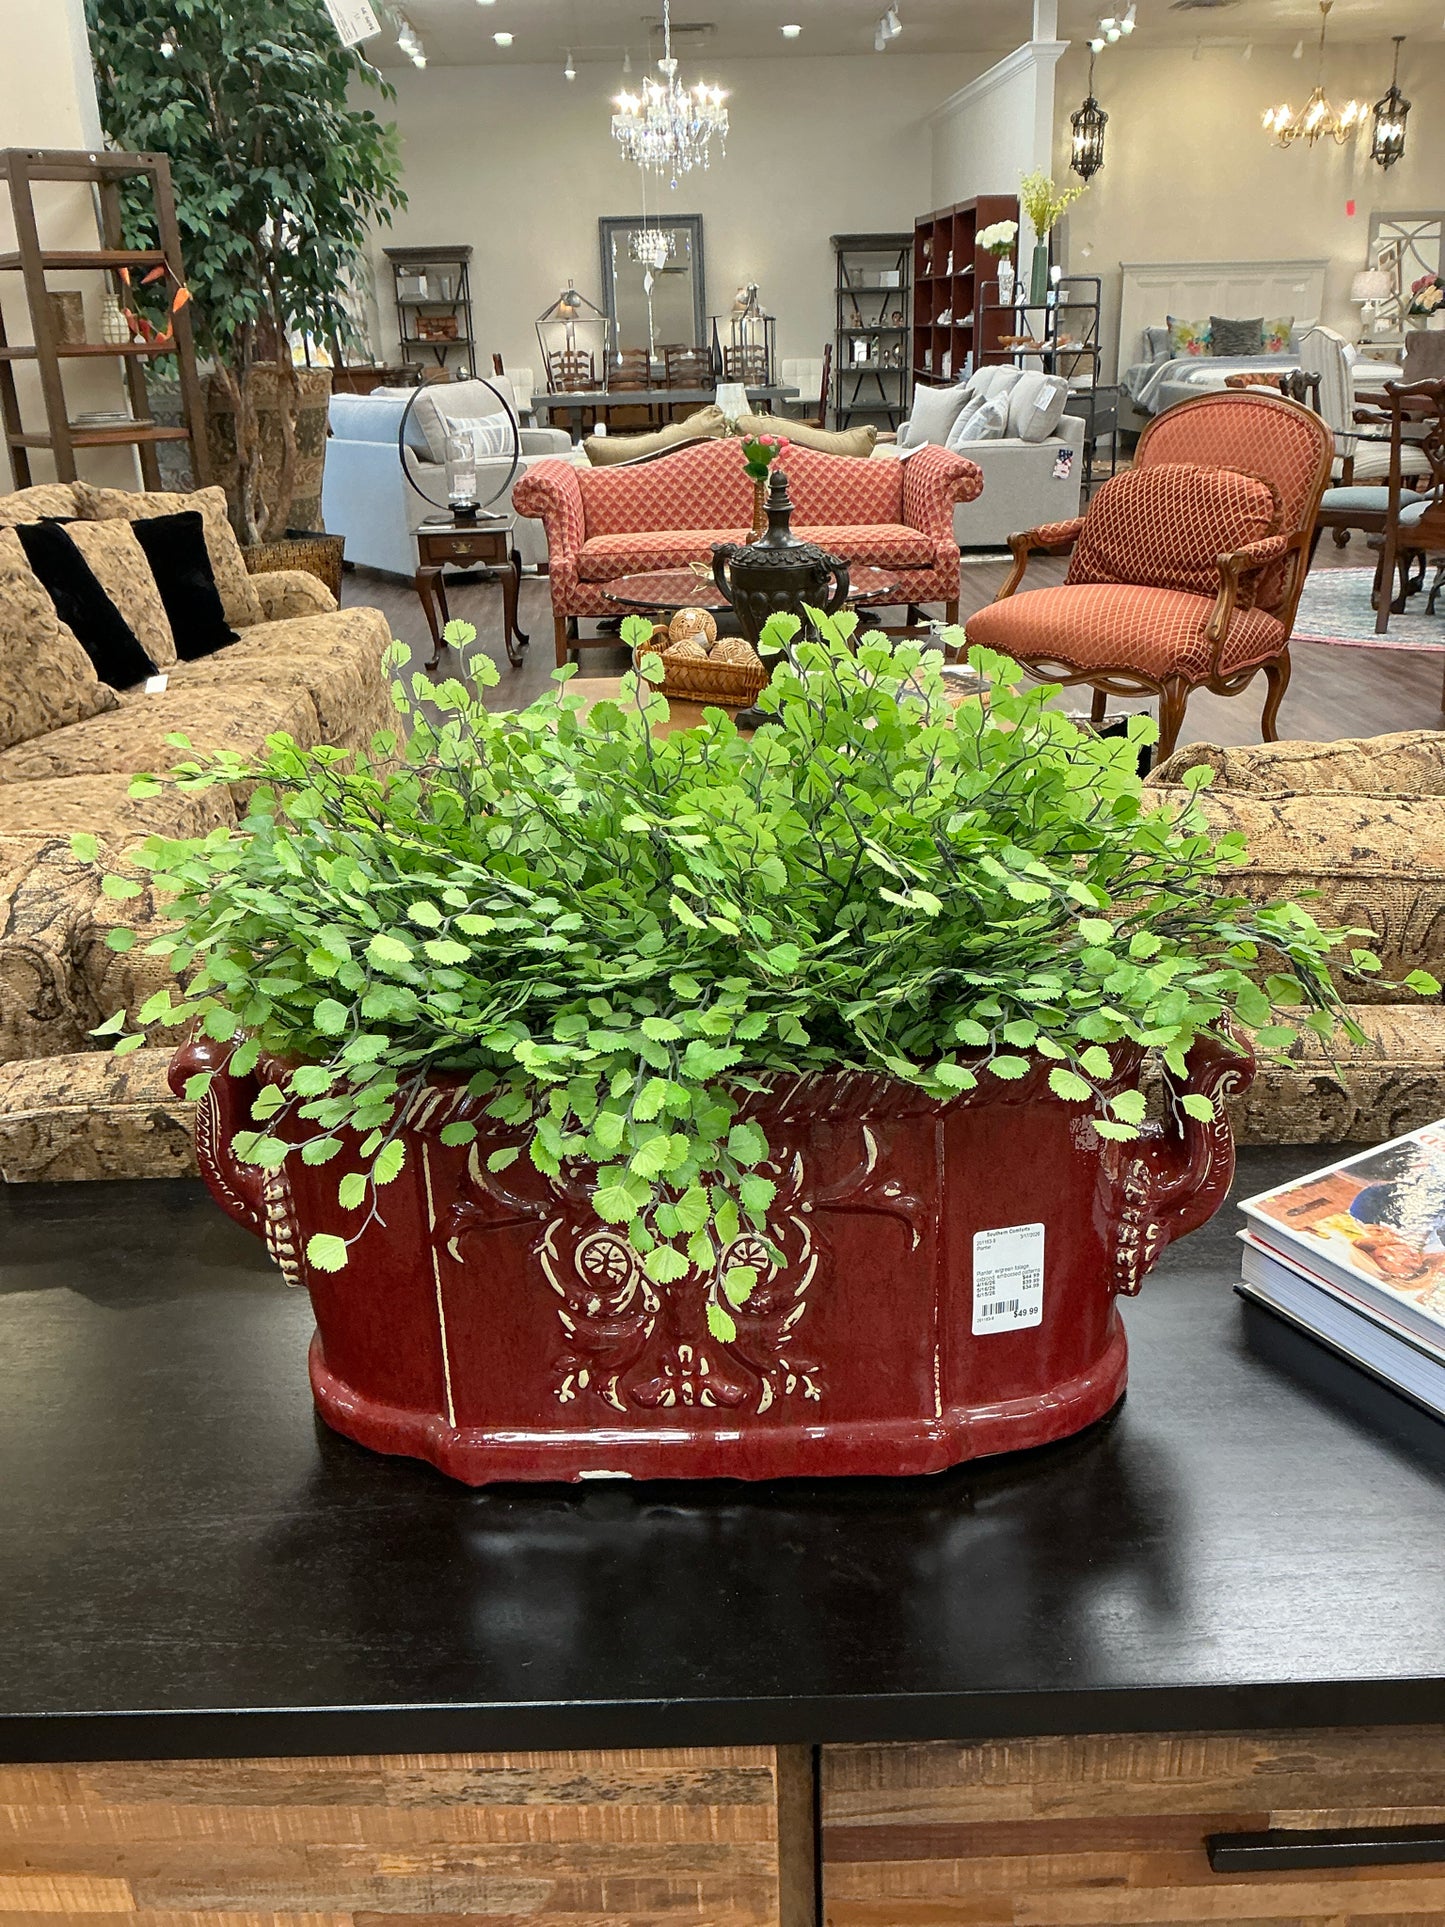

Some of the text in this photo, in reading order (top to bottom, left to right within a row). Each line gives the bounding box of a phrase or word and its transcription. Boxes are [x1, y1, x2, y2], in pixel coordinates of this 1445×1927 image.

[997, 1270, 1021, 1279] embossed
[1022, 1268, 1040, 1276] patterns
[1013, 1306, 1039, 1318] $49.99
